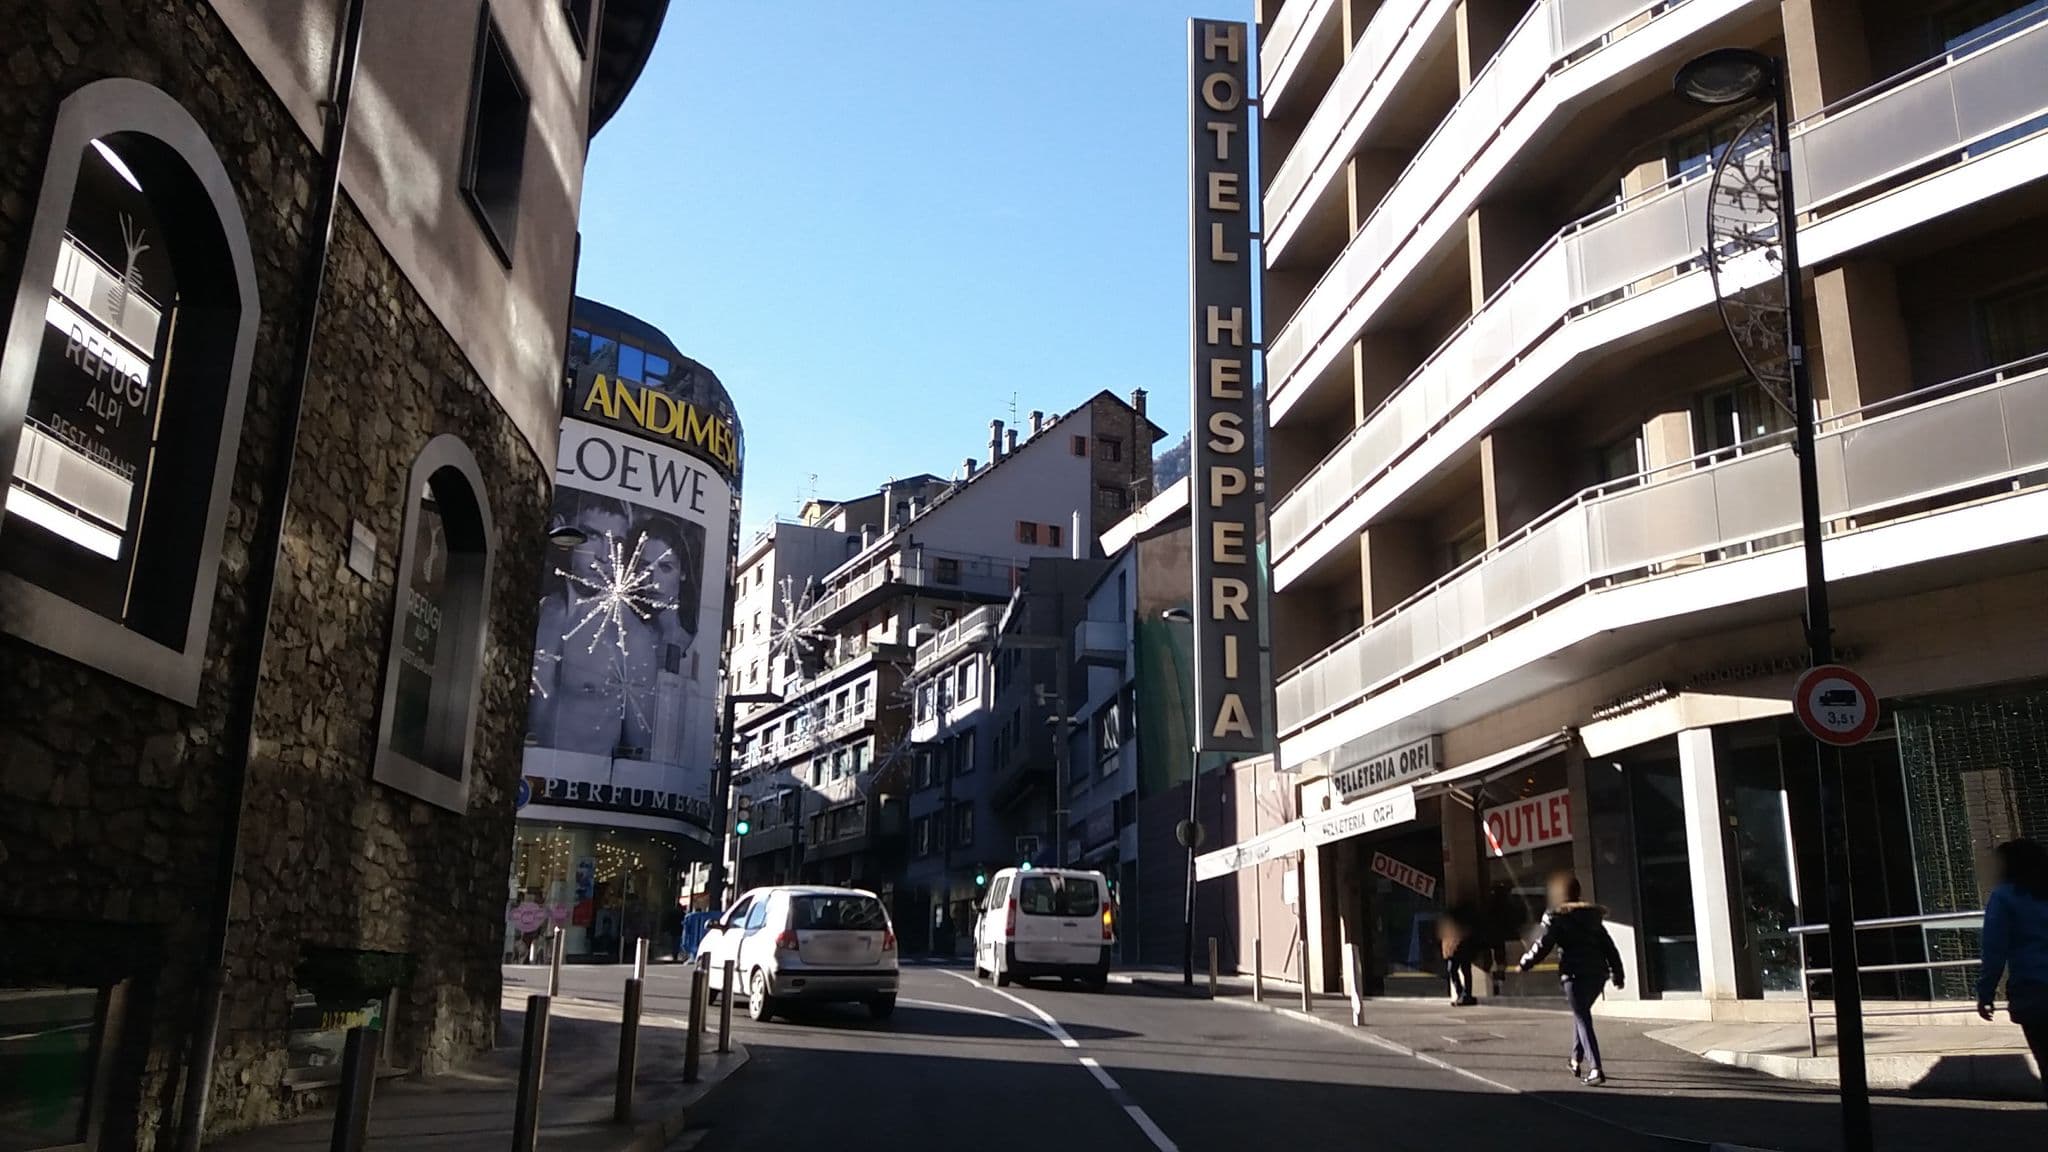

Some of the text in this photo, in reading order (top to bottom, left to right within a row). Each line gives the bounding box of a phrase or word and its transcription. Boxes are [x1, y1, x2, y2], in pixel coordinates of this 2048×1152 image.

[65, 323, 152, 416] REFUGI
[1202, 23, 1254, 739] HOTEL HESPERIA
[1827, 711, 1848, 726] 3,5
[1335, 743, 1430, 796] PELLETERIA ORFI
[1487, 794, 1573, 850] OUTLET
[1374, 853, 1435, 893] OUTLET
